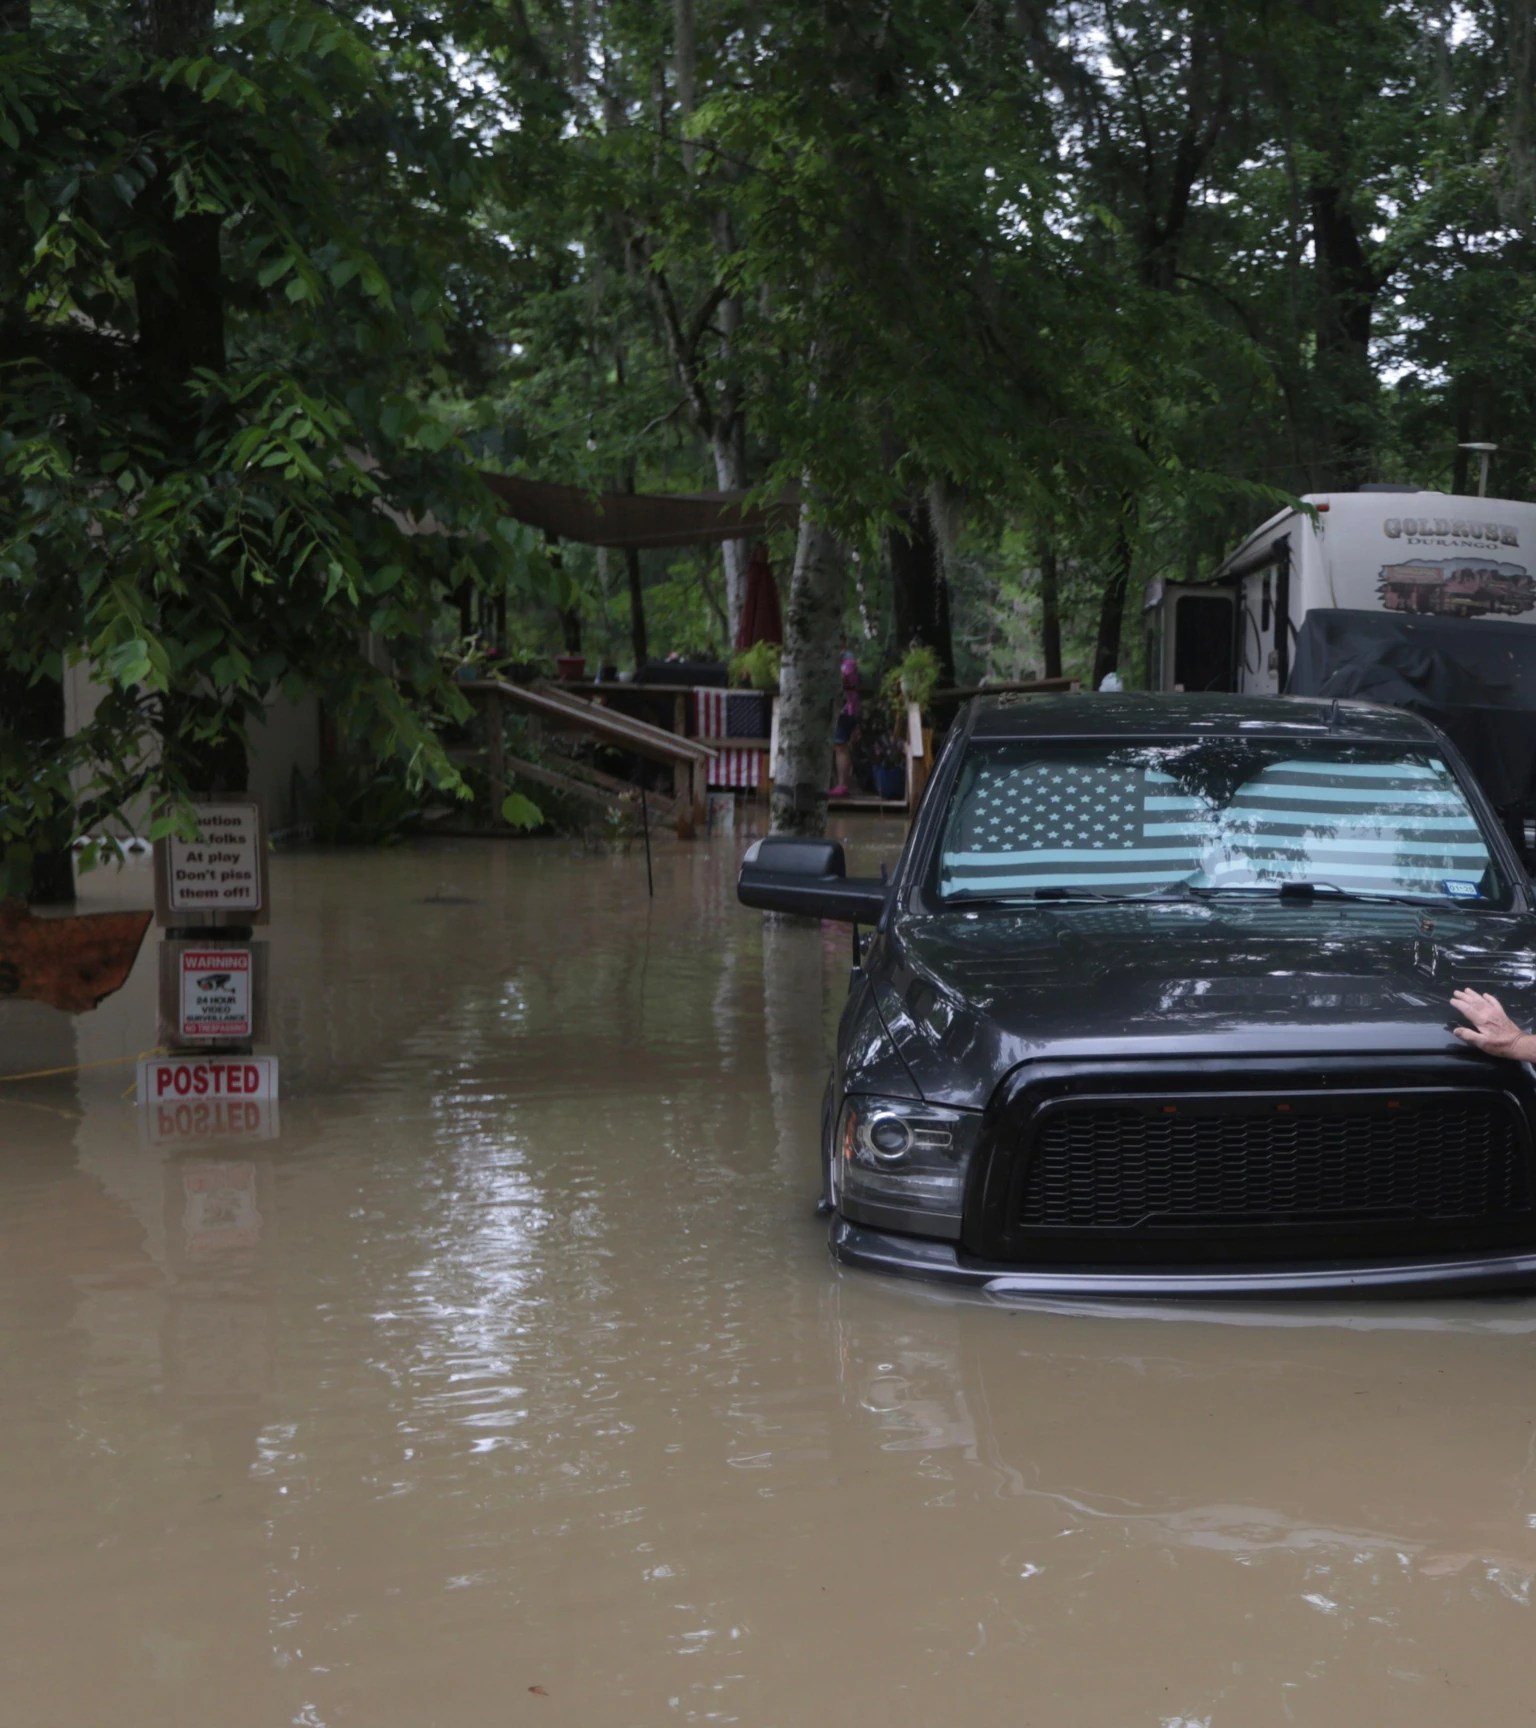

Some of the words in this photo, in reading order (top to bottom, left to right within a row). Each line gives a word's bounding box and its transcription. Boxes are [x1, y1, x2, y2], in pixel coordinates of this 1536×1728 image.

[1383, 518, 1519, 547] GOLDRUSH
[1407, 538, 1498, 550] DURANGO
[197, 815, 242, 827] ution
[209, 833, 246, 844] folks
[186, 851, 203, 862] At
[208, 851, 240, 864] play
[176, 869, 216, 880] Don't
[221, 869, 252, 882] piss
[180, 888, 219, 898] them
[223, 887, 250, 898] off!
[185, 956, 248, 968] WARNING
[210, 996, 236, 1004] HOUR
[185, 1024, 196, 1032] NO
[157, 1065, 260, 1096] POSTED
